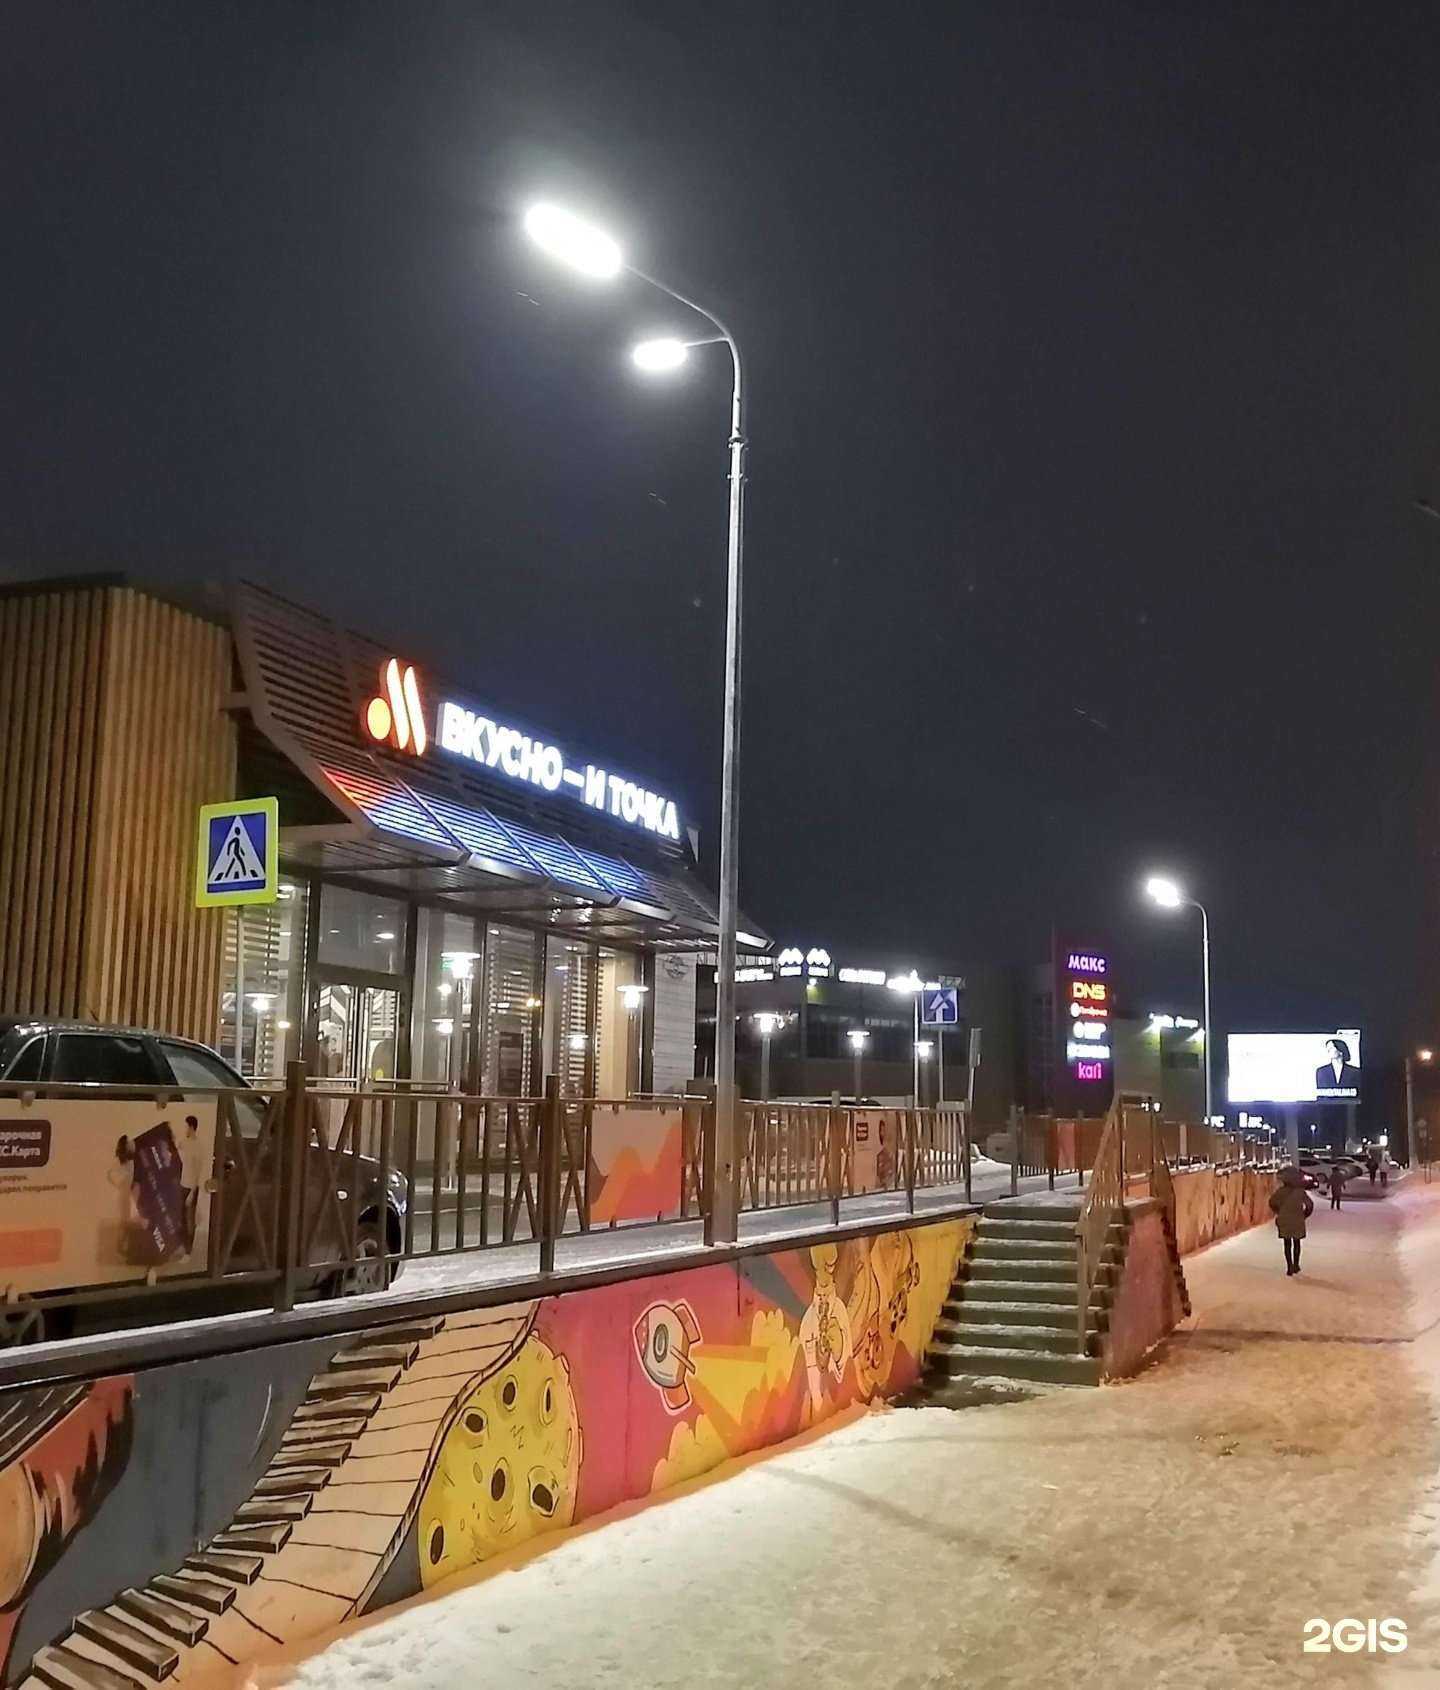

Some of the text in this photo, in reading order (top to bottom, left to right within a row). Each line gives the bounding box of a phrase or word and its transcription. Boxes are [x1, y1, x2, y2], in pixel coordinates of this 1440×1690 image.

[438, 702, 562, 791] ВКУСНО
[608, 775, 681, 840] ТОЧКА
[1072, 981, 1106, 1001] DNS
